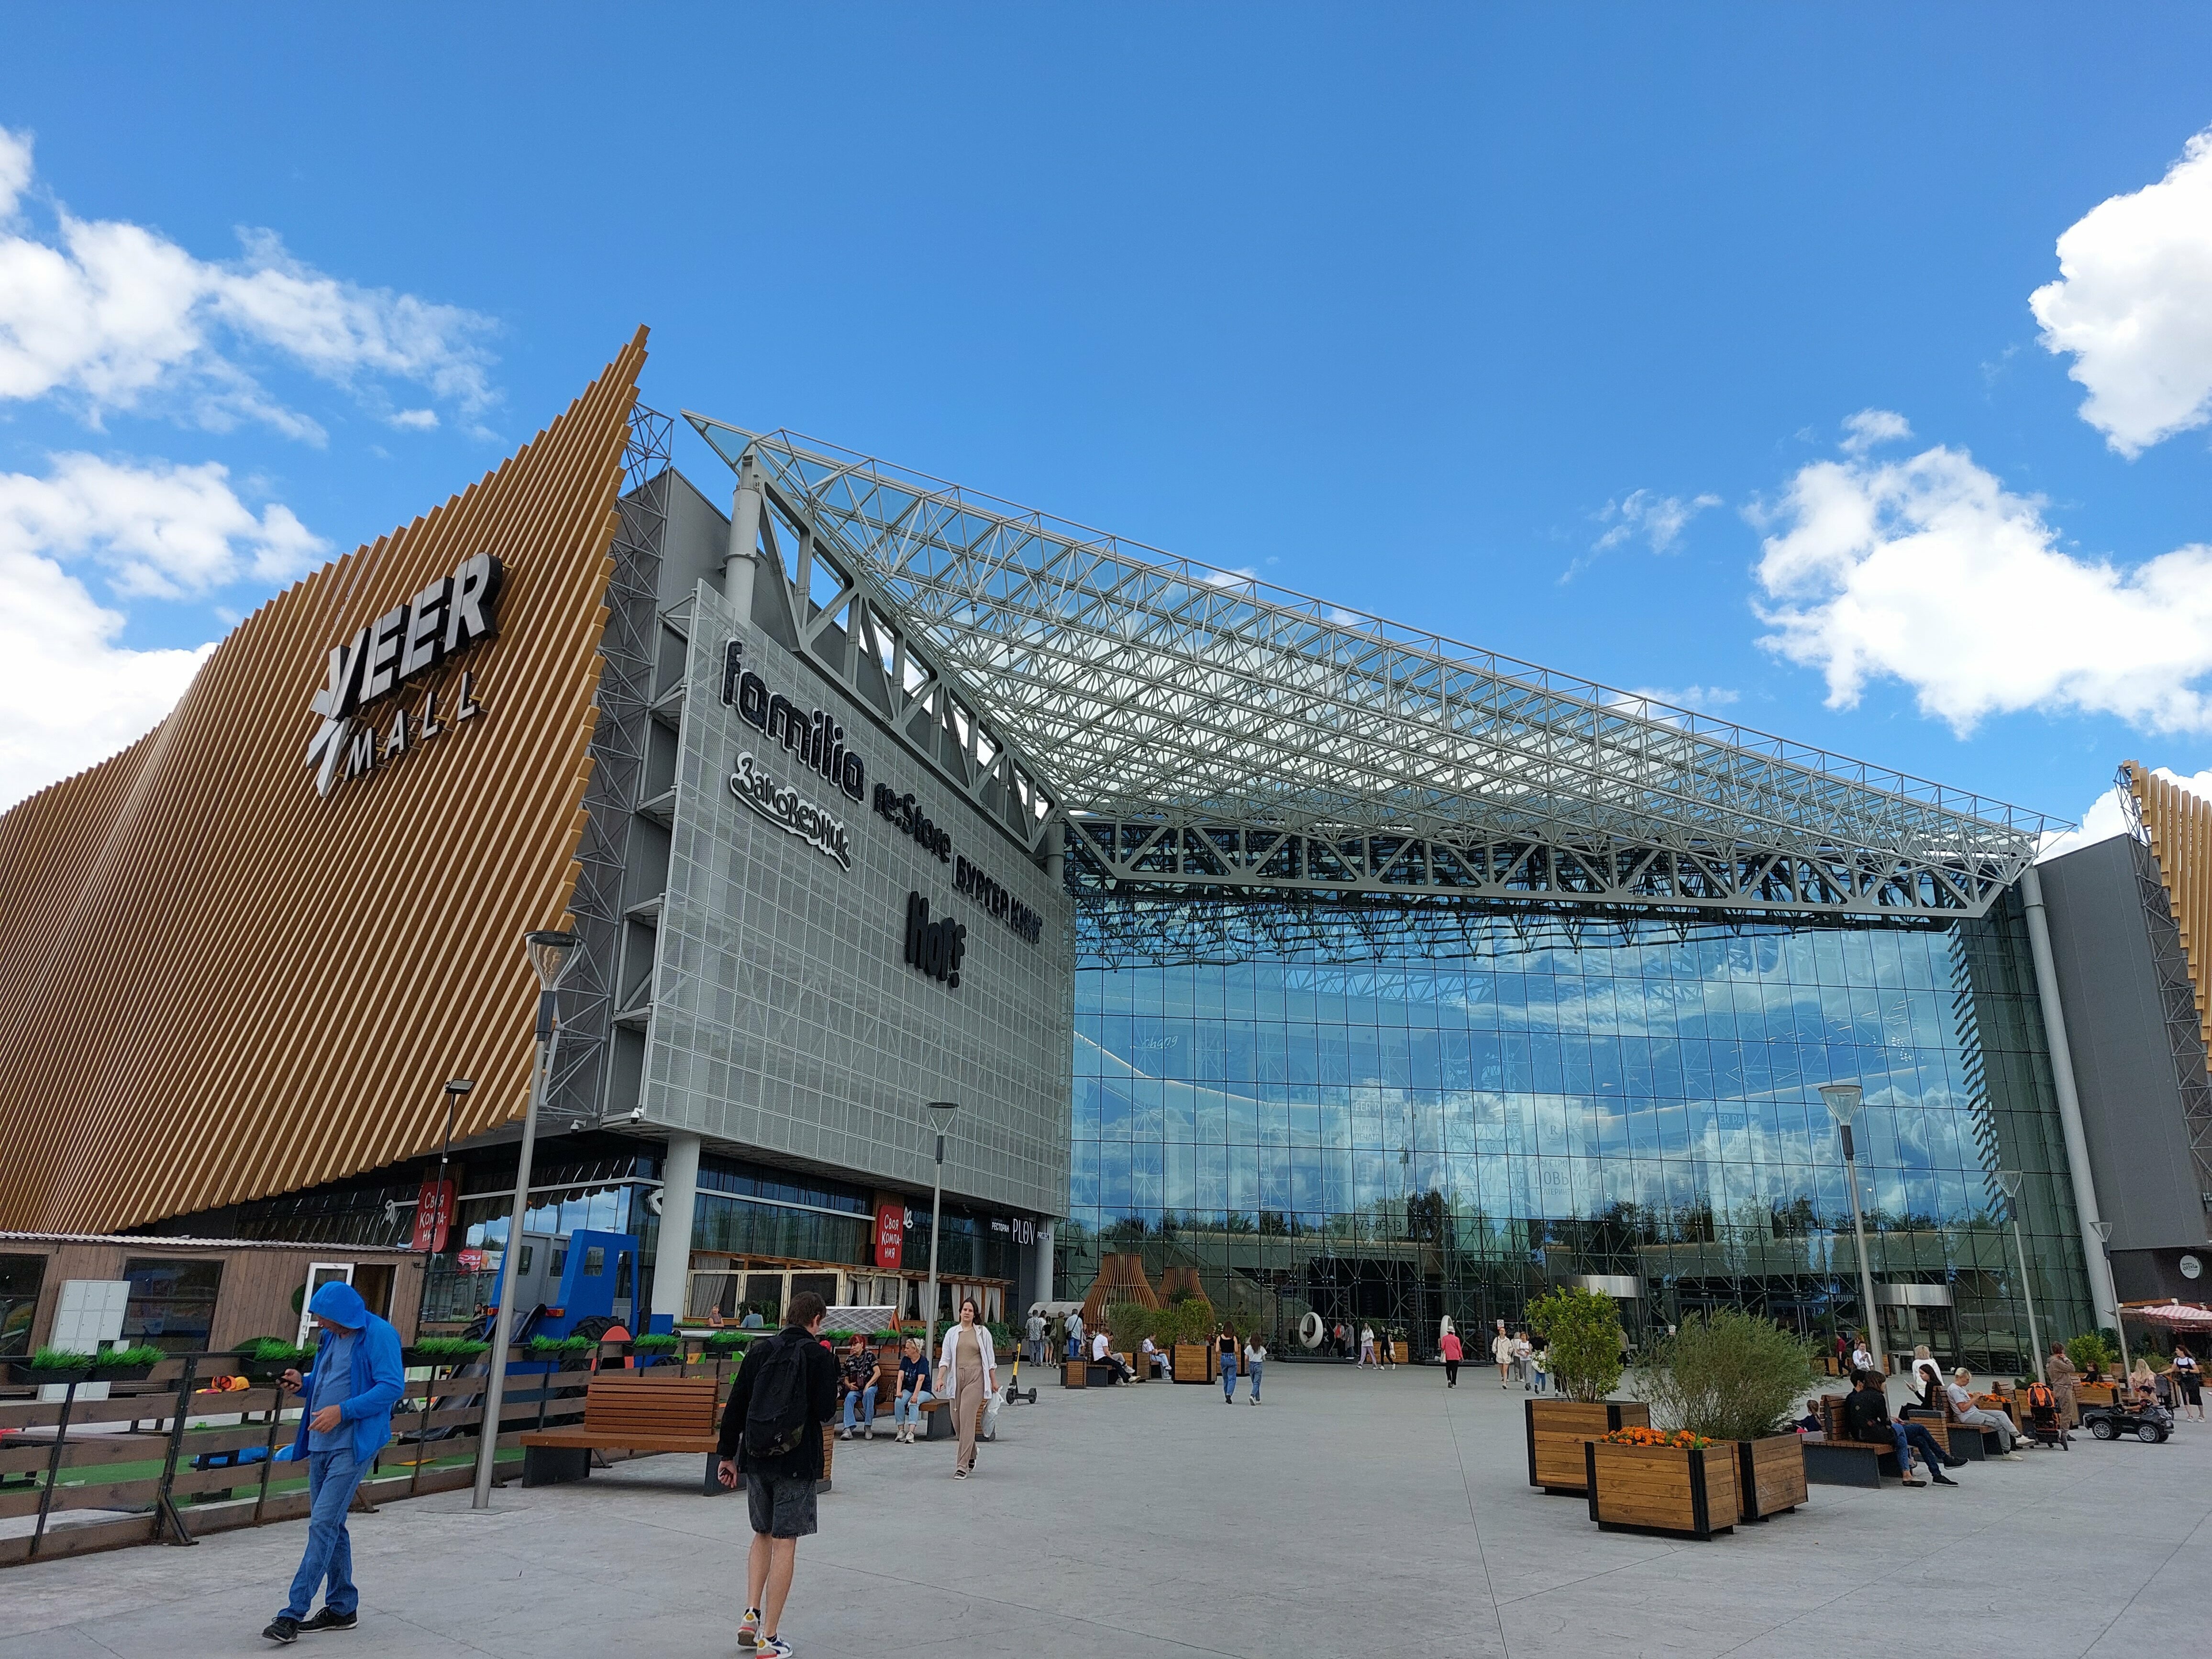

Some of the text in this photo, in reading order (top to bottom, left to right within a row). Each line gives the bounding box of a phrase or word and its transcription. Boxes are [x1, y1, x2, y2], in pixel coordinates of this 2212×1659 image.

[316, 552, 502, 722] VEER
[343, 671, 478, 782] MALL
[721, 637, 864, 804] familia
[951, 854, 1009, 926] БУРГЕР
[1708, 1114, 1730, 1124] VER
[424, 1192, 444, 1209] Свя
[991, 1222, 1009, 1233] РЕСТОРАН
[1013, 1218, 1051, 1245] PLOV PROJECT
[1721, 1229, 1768, 1242] 23-03-3
